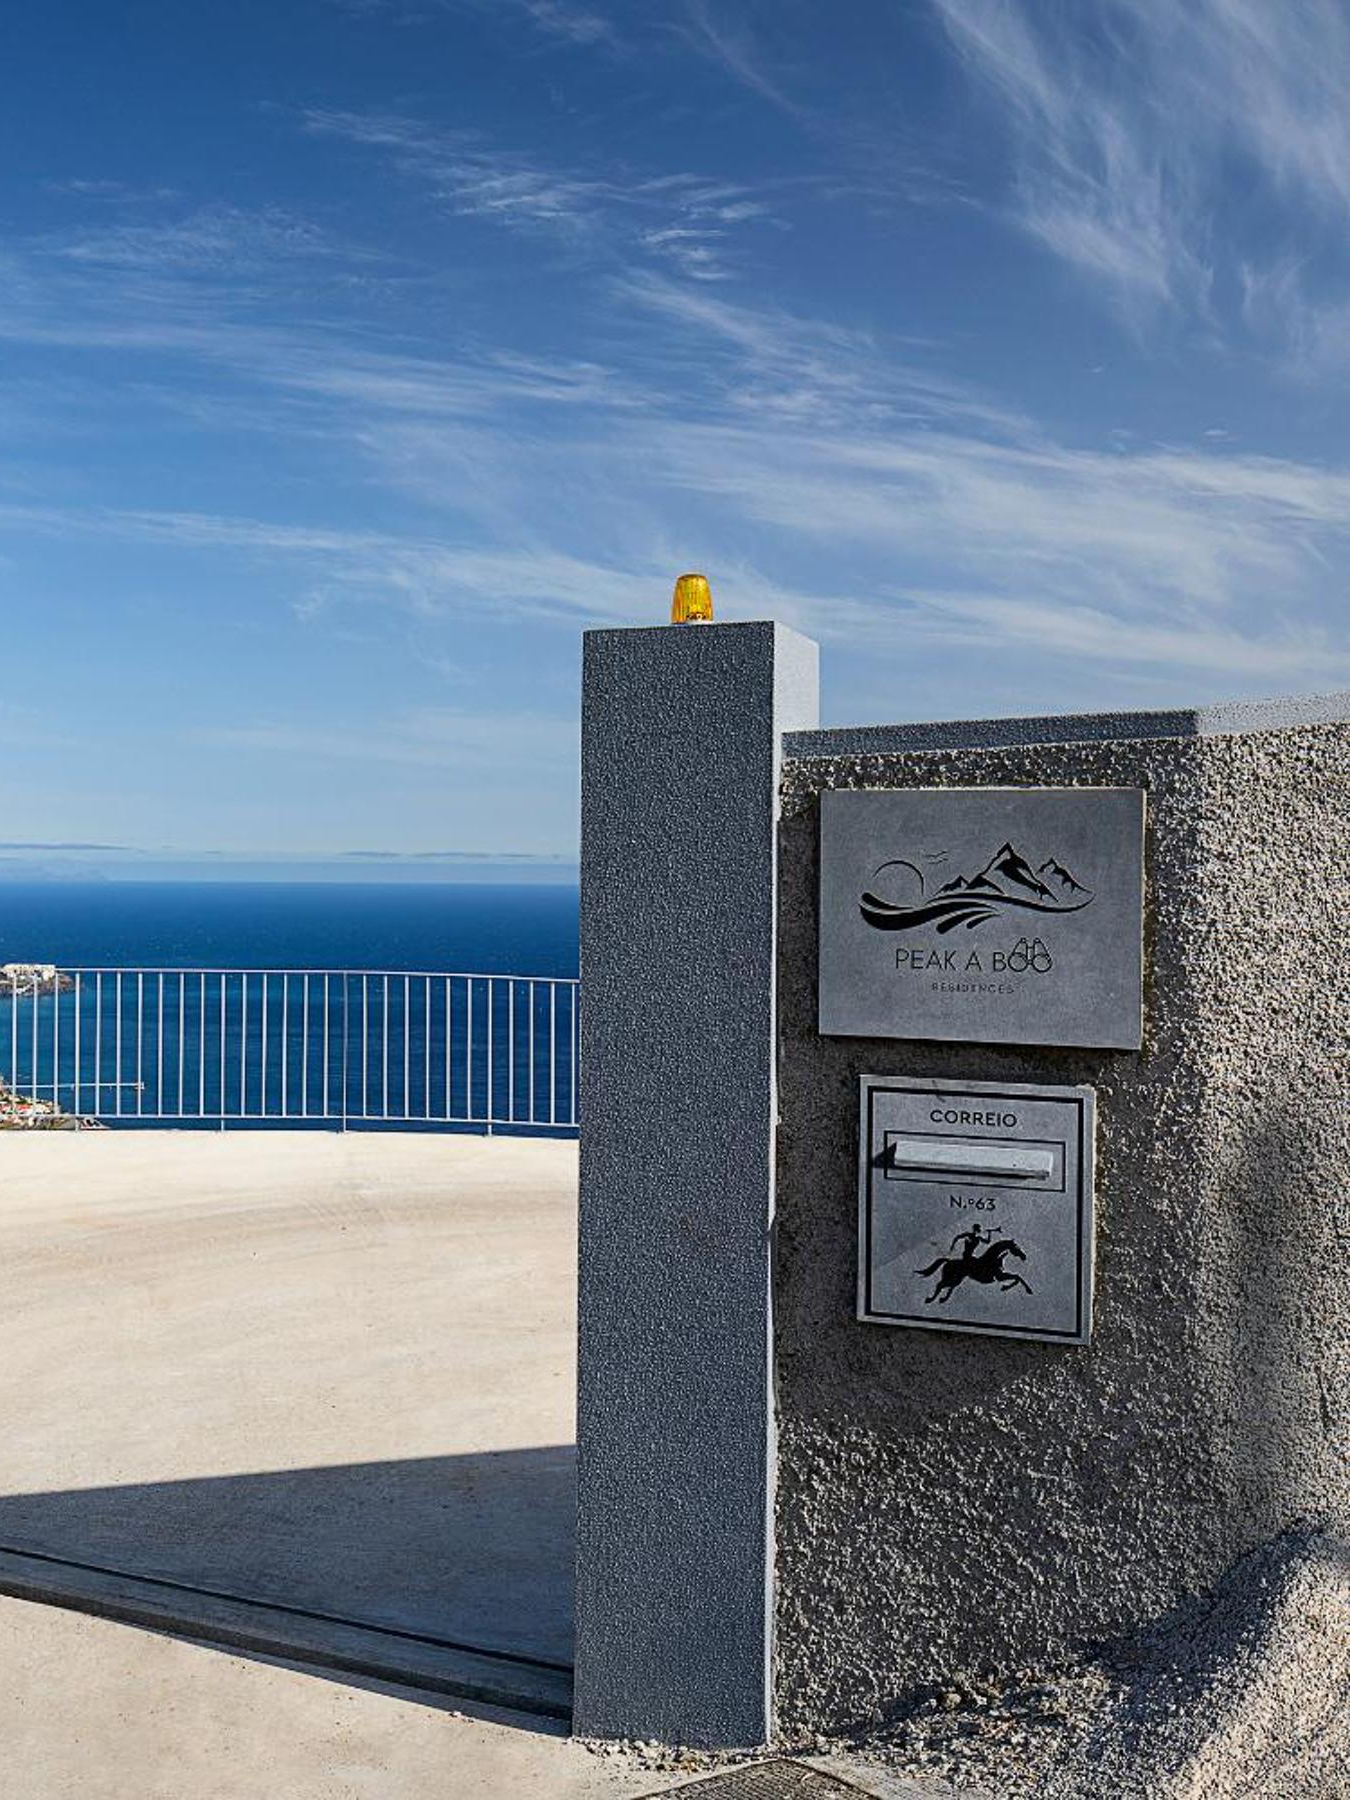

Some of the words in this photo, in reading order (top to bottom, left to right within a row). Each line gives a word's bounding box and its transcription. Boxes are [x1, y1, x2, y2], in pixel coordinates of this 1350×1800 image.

[895, 948, 957, 971] PEAK
[965, 951, 982, 971] A
[993, 942, 1053, 973] BOO
[931, 982, 1015, 994] RESIDENCES
[930, 1110, 1017, 1127] CORREIO
